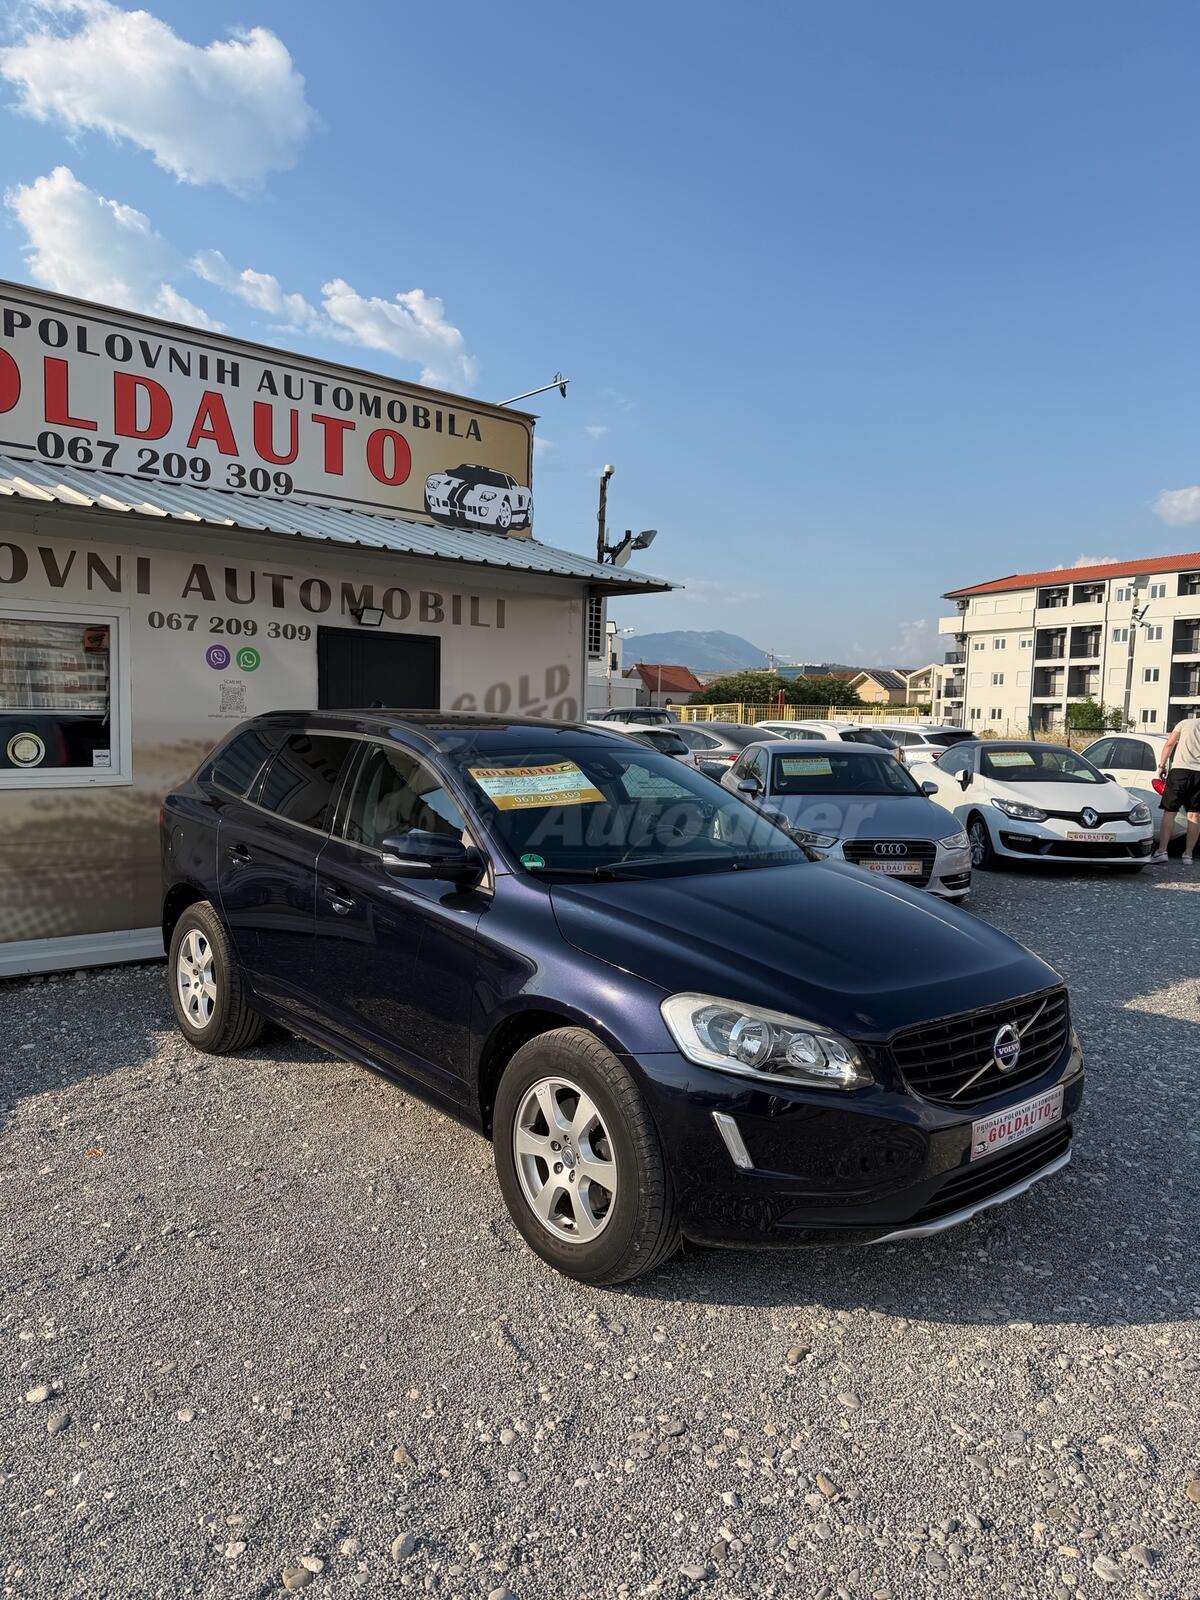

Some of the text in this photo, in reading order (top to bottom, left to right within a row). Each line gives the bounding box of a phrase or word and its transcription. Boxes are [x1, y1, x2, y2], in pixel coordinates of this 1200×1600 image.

[4, 308, 482, 442] POLOVNIH AUTOMOBILA
[36, 431, 294, 496] 067 209 309
[182, 563, 505, 629] AUTOMOBILI
[148, 610, 312, 642] 067 209 309
[450, 664, 570, 713] GOLD
[474, 766, 557, 778] GOLD AUTO
[514, 791, 581, 803] 067 209 309
[998, 1042, 1019, 1054] VOLVO
[989, 1103, 1051, 1142] GOLDAUTO
